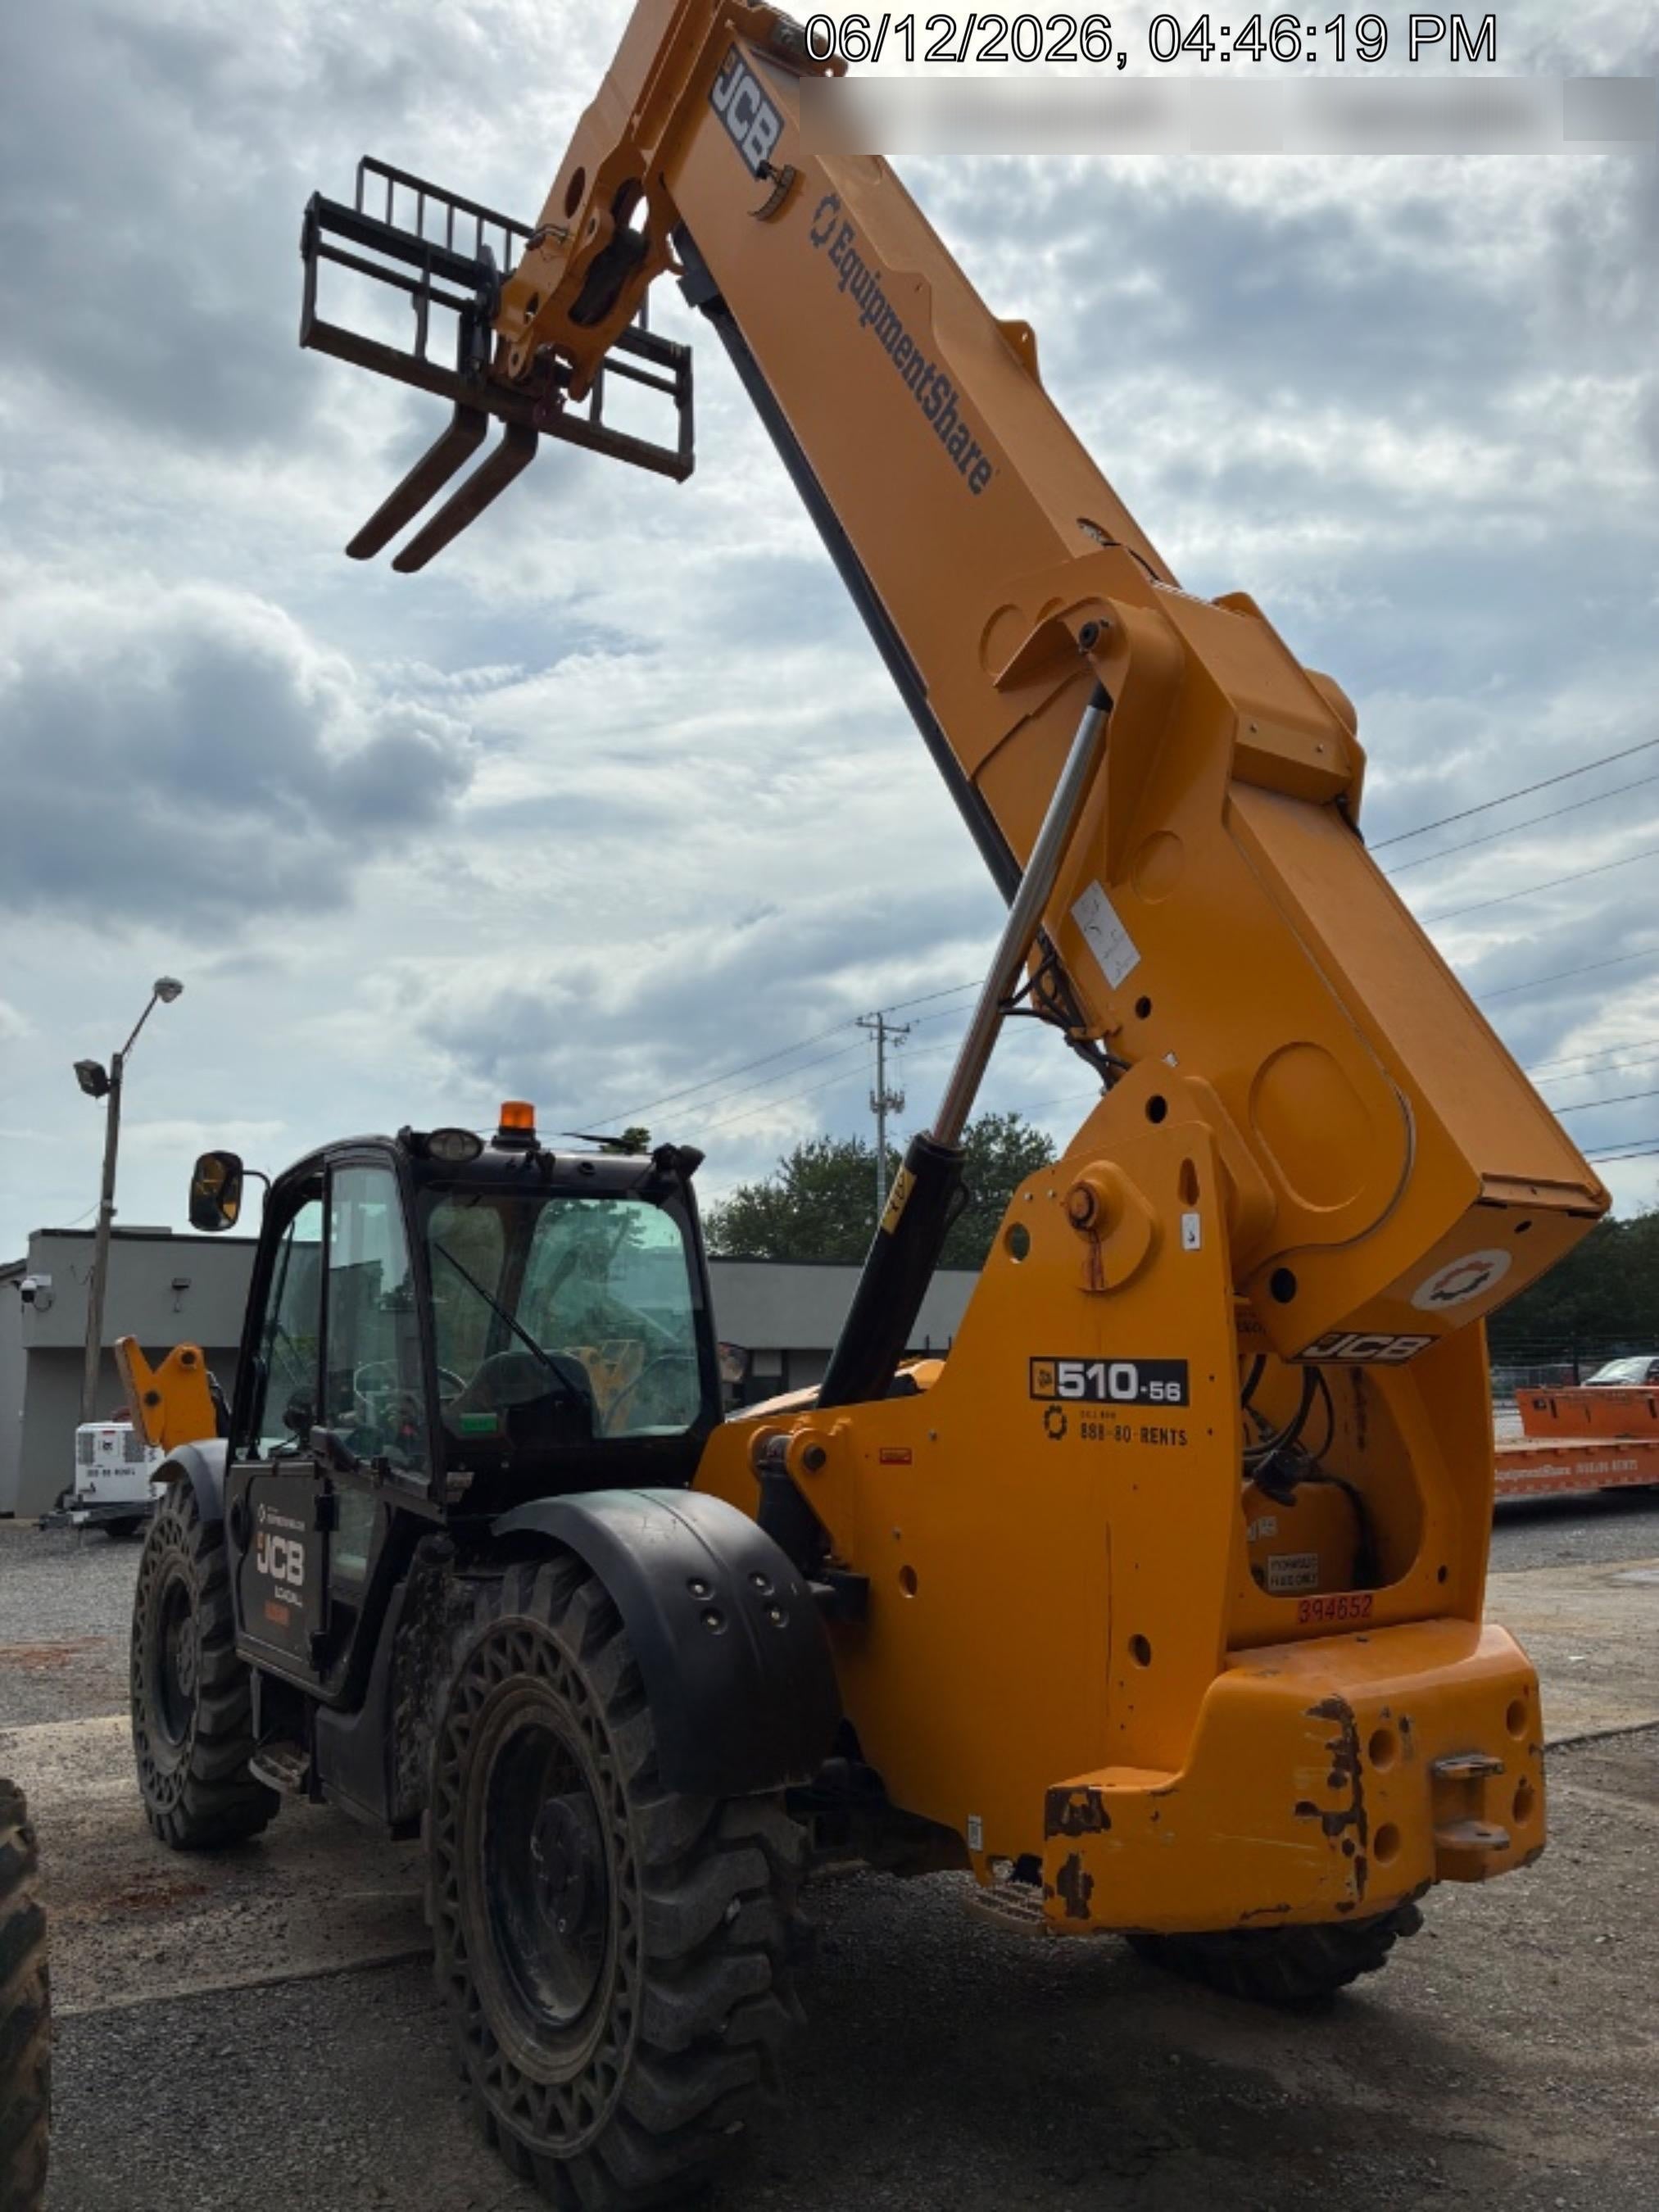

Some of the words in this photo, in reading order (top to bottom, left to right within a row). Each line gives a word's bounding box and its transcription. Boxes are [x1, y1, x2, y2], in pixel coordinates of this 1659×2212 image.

[711, 61, 780, 171] JCB
[827, 220, 992, 495] EquipmentShare
[1303, 1334, 1433, 1361] JCB
[1058, 1362, 1181, 1402] 510-56
[256, 1532, 305, 1586] JCB
[1299, 1594, 1373, 1624] 394652
